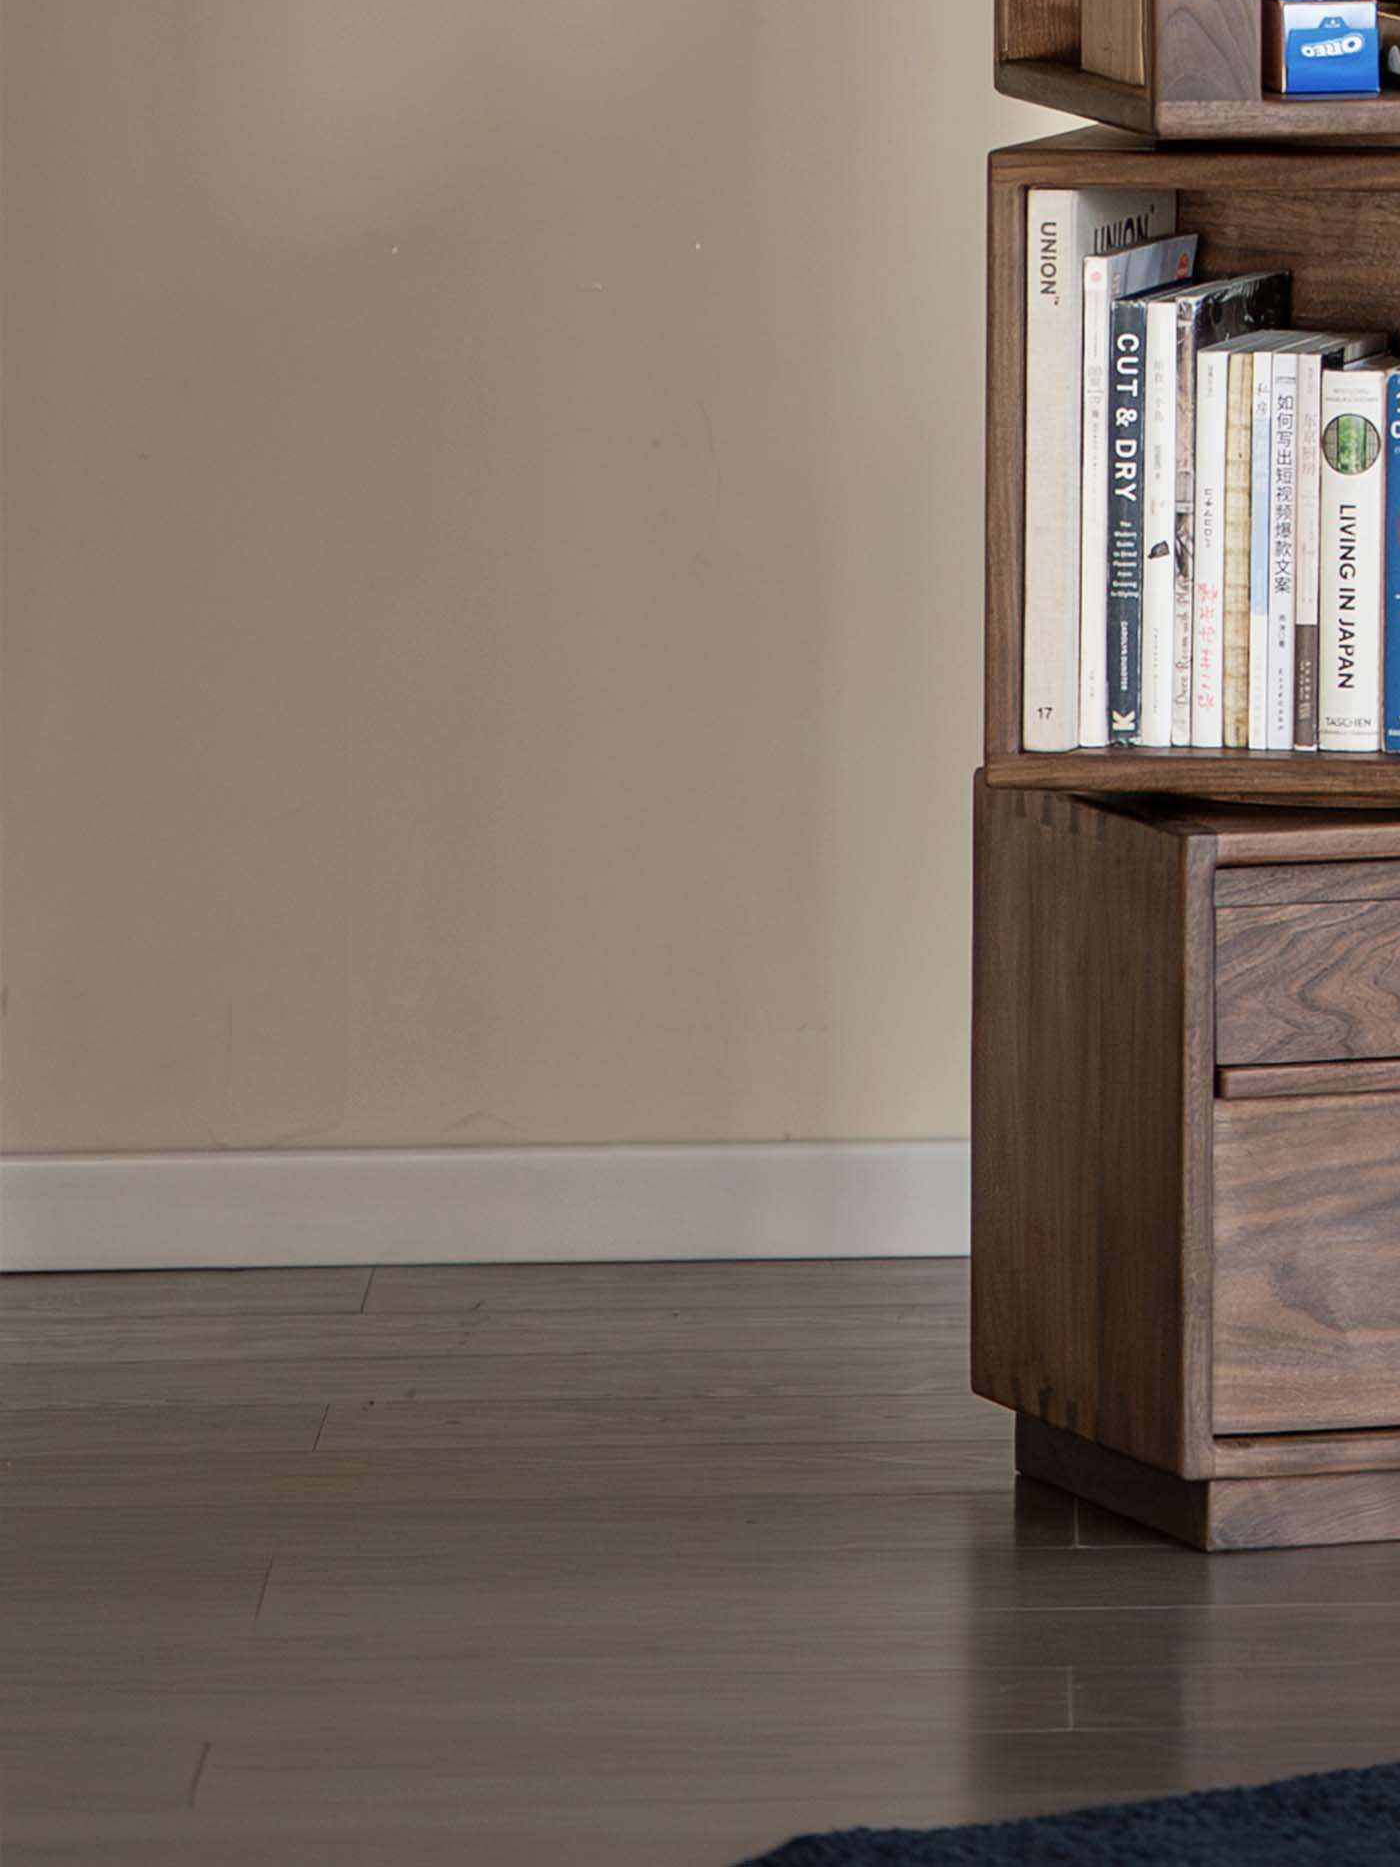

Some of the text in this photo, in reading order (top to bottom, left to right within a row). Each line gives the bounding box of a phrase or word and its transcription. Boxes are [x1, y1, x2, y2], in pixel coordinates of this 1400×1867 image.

[1300, 33, 1363, 59] OREO
[1040, 221, 1057, 295] UNION
[1116, 333, 1140, 398] CUT
[1115, 407, 1138, 428] &
[1114, 438, 1138, 502] DRY
[1337, 504, 1357, 689] LIVING IN JAPAN
[1037, 707, 1053, 720] 17
[1112, 710, 1136, 731] K
[1325, 717, 1372, 726] TASCHEN
